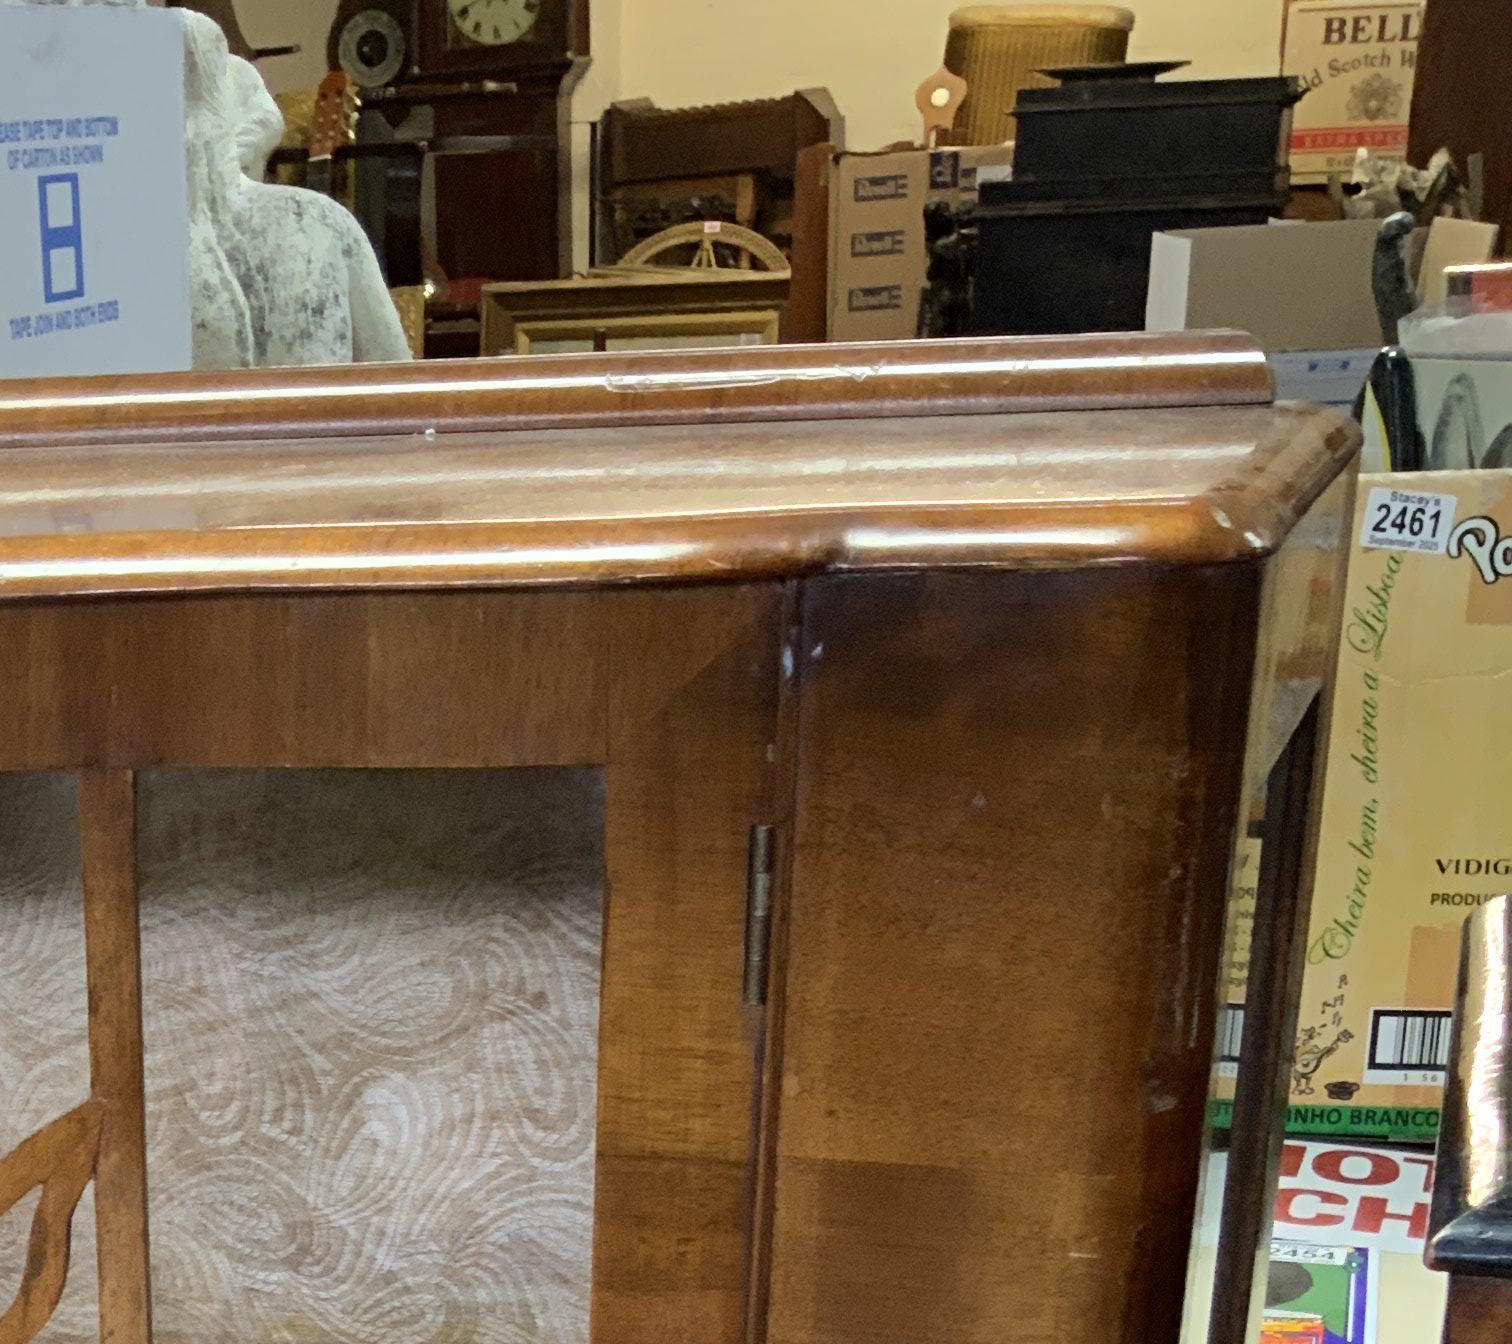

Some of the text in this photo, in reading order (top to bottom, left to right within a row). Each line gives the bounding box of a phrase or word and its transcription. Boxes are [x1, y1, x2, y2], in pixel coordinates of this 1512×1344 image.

[1296, 68, 1324, 91] ld
[1328, 49, 1391, 78] Scotch
[1390, 491, 1441, 507] Stacey's
[1372, 503, 1441, 538] 2461
[1363, 669, 1378, 692] a
[1349, 697, 1380, 784] cheira
[1429, 893, 1491, 907] PRODU
[1287, 1107, 1439, 1127] INHO BRANCO
